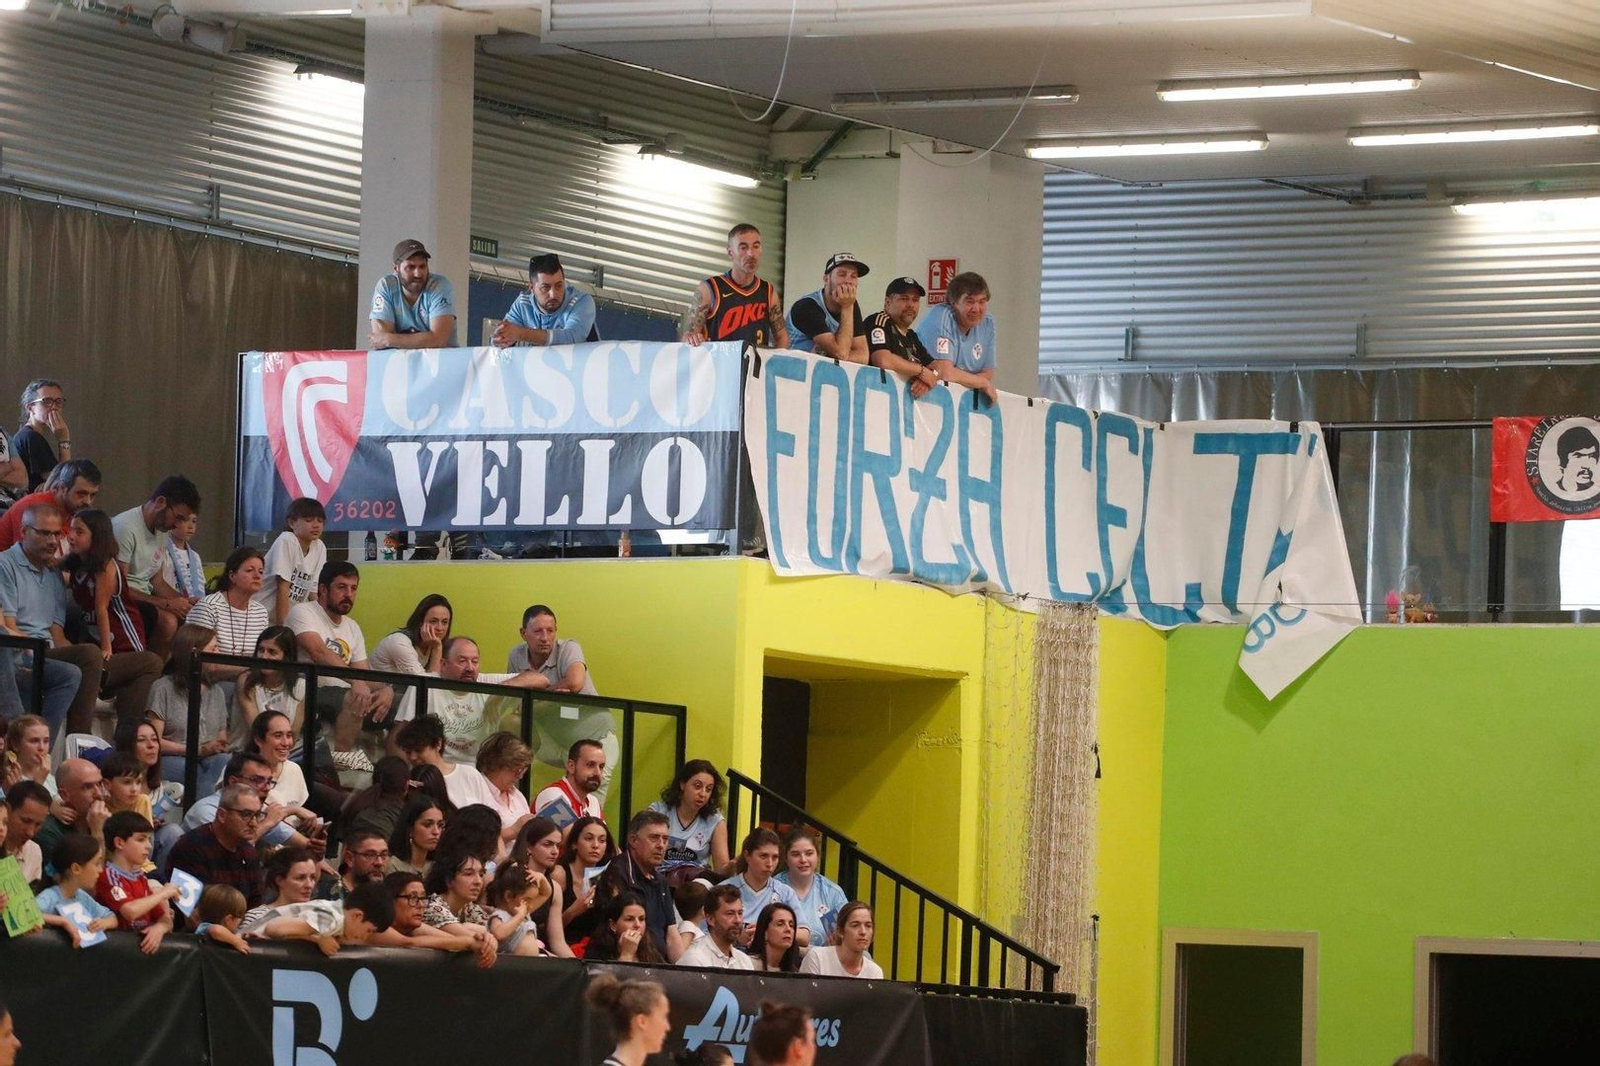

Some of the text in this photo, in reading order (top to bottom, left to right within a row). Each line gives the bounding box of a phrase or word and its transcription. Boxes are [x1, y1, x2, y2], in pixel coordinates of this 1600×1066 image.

[381, 340, 717, 431] CASCO
[333, 500, 396, 522] 36202
[387, 436, 707, 527] VELLO
[764, 353, 1317, 628] FORZA CELT
